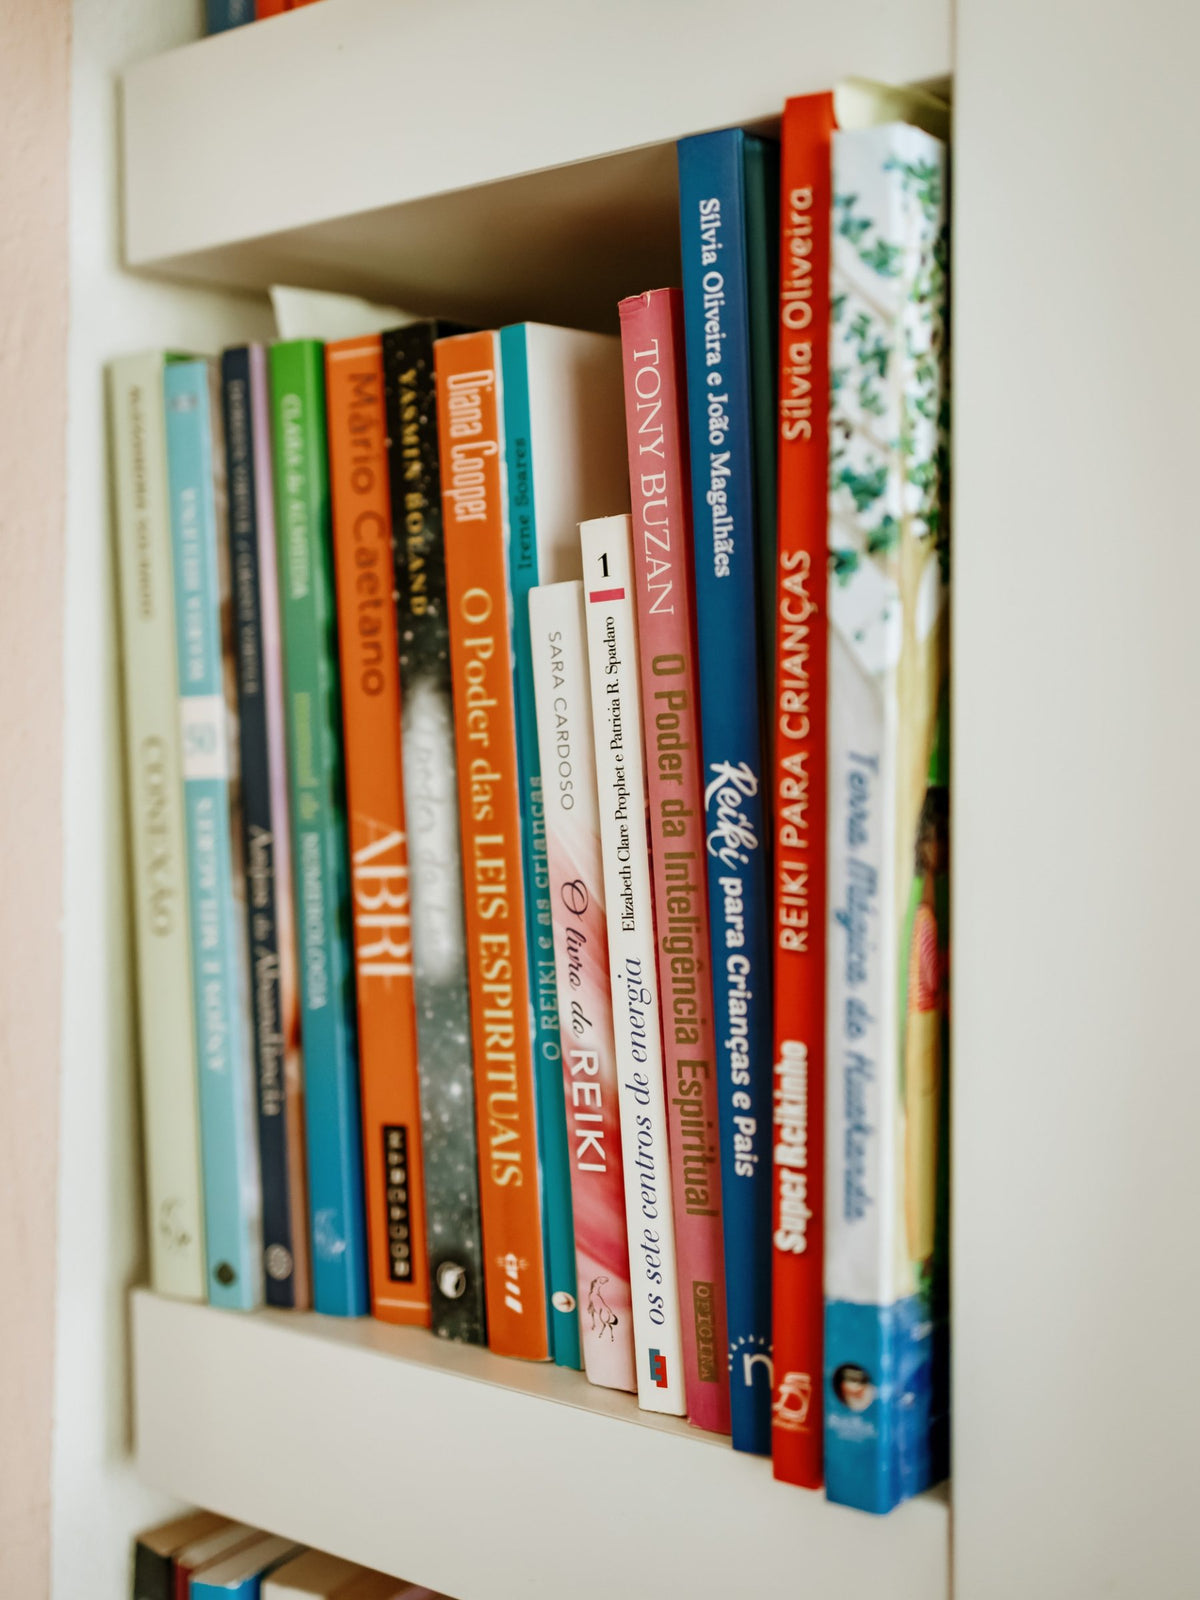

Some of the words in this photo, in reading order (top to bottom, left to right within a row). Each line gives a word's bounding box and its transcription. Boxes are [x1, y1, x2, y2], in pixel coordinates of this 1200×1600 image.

[697, 199, 720, 266] Sílvia
[781, 187, 813, 328] Oliveira
[702, 272, 726, 366] Oliveira
[445, 369, 493, 438] Diana
[632, 339, 664, 458] TONY
[707, 372, 721, 386] e
[779, 341, 813, 439] Sílvia
[397, 369, 421, 481] YASMIN
[706, 392, 728, 444] João
[441, 441, 497, 523] Cooper
[513, 436, 529, 505] Soares
[640, 471, 673, 615] BUZAN
[706, 453, 733, 578] Magalhães
[597, 553, 611, 578] 1
[351, 511, 386, 695] Caetano
[460, 587, 492, 624] O
[549, 631, 566, 689] SARA
[603, 615, 622, 673] Spadaro
[651, 654, 684, 676] O
[779, 549, 817, 738] CRIANÇAS
[464, 638, 494, 746] Poder
[605, 677, 620, 694] R.
[552, 697, 574, 811] CARDOSO
[607, 697, 623, 749] Patricia
[614, 753, 624, 761] e
[654, 690, 689, 786] Poder
[468, 758, 501, 821] das
[613, 764, 631, 819] Prophet
[660, 799, 692, 838] da
[704, 760, 757, 869] Reiki
[779, 751, 809, 847] PARA
[473, 834, 507, 919] LEIS
[616, 823, 631, 861] Clare
[559, 879, 588, 921] O
[618, 864, 635, 931] Elizabeth
[717, 876, 745, 948] para
[779, 859, 809, 951] REIKI
[564, 928, 586, 990] livro
[662, 851, 705, 1044] Inteligência
[538, 960, 559, 1029] REIKI
[570, 999, 592, 1037] do
[617, 956, 652, 1062] energia
[726, 954, 753, 1085] Crianças
[479, 934, 522, 1187] ESPIRITUAIS
[543, 1040, 561, 1059] O
[569, 1050, 605, 1172] REIKI
[624, 1071, 650, 1104] de
[731, 1091, 748, 1107] e
[773, 1039, 807, 1167] Reikinho
[632, 1113, 657, 1219] centros
[671, 1059, 718, 1217] Espiritual
[732, 1116, 757, 1178] Pais
[774, 1167, 812, 1253] Super
[638, 1228, 662, 1283] sete
[647, 1292, 665, 1324] os
[694, 1284, 713, 1379] OFICINA
